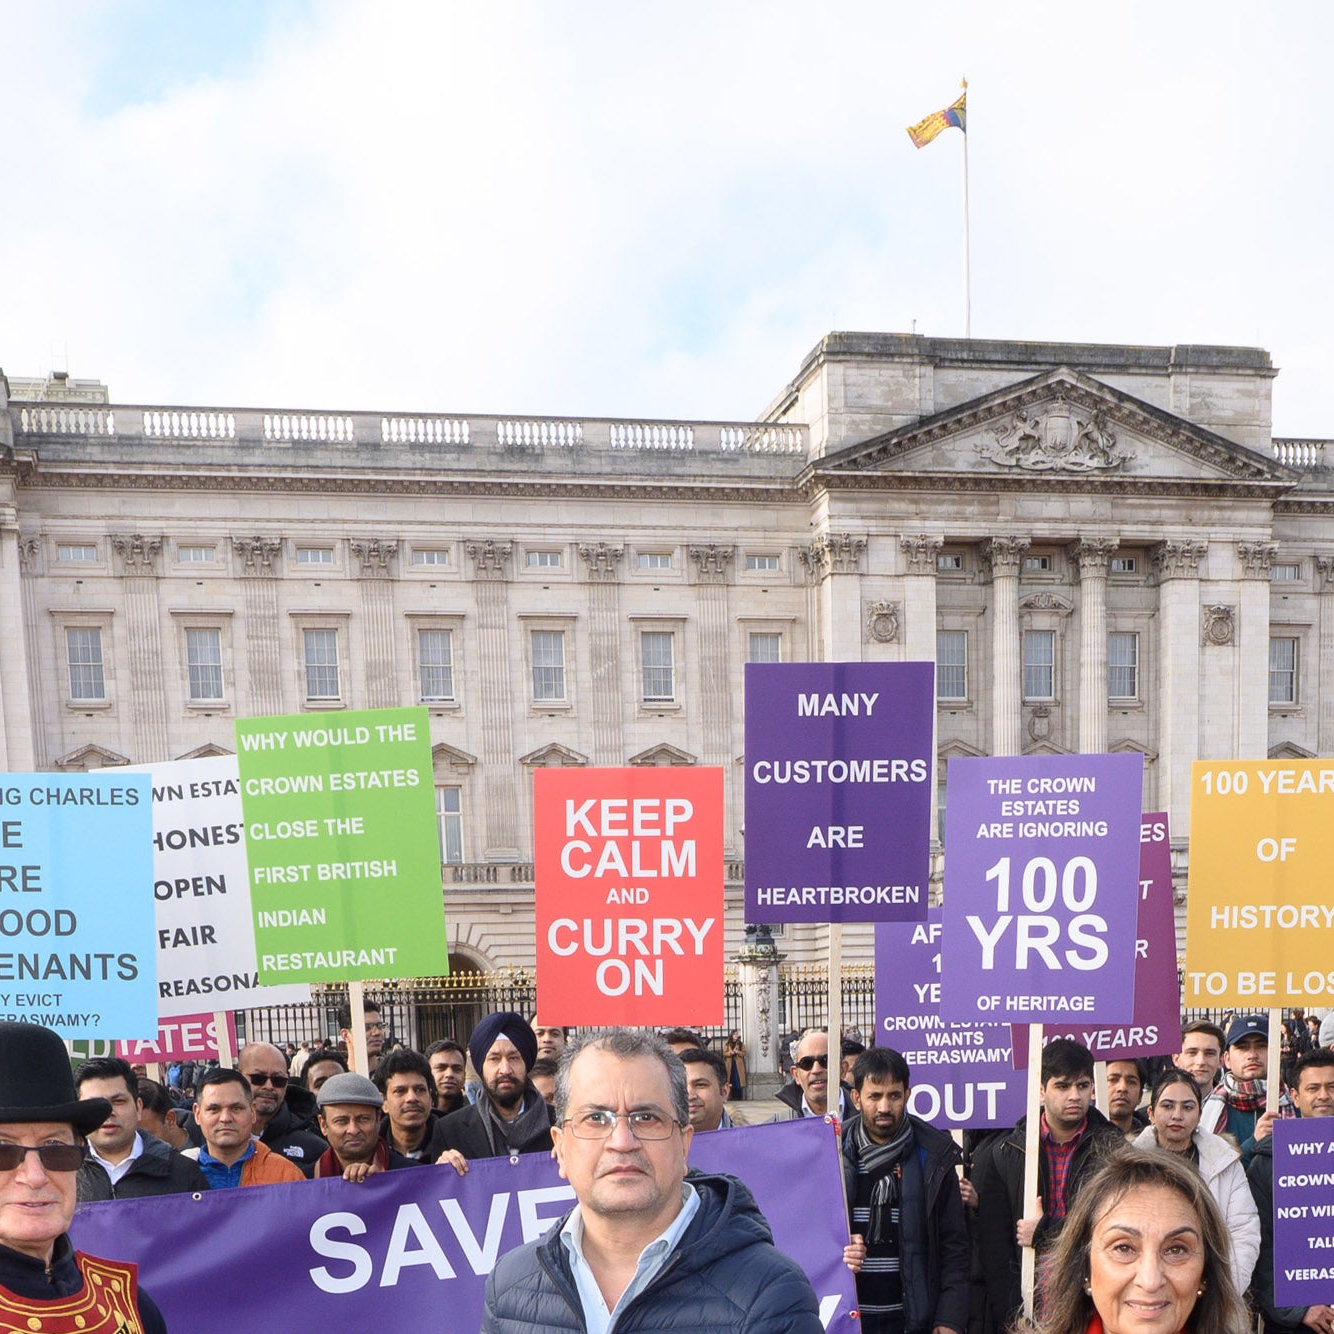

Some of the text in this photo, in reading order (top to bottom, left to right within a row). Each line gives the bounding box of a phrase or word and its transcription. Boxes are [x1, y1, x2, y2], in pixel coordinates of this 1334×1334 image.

[798, 693, 879, 716] MANY
[241, 724, 416, 751] WHY WOULD THE
[246, 769, 419, 796] CROWN ESTATES
[753, 759, 927, 783] CUSTOMERS
[1201, 771, 1248, 794] 100
[30, 788, 139, 805] CHARLES
[987, 777, 1095, 794] THE CROWN
[566, 799, 693, 836] KEEP
[1002, 800, 1079, 816] ESTATES
[250, 817, 364, 840] CLOSE THE
[807, 826, 863, 848] ARE
[977, 821, 1107, 838] ARE IGNORING
[561, 840, 696, 878] CALM
[1257, 838, 1296, 861] OF
[254, 860, 397, 884] FIRST BRITISH
[155, 875, 227, 900] OPEN
[758, 886, 919, 905] HEARTBROKEN
[986, 856, 1097, 912] 100
[606, 888, 649, 904] AND
[258, 908, 326, 928] INDIAN
[159, 925, 217, 949] FAIR
[548, 918, 715, 956] CURRY
[966, 914, 1108, 970] YRS
[262, 948, 397, 971] RESTAURANT
[596, 959, 663, 996] ON
[1189, 972, 1227, 995] TO
[1238, 972, 1276, 994] BE
[16, 994, 62, 1006] EVICT
[977, 996, 1094, 1011] OF HERITAGE
[926, 1031, 984, 1046] WANTS
[1083, 1026, 1158, 1050] YEARS
[907, 1082, 1006, 1122] OUT
[1288, 1143, 1324, 1155] WHY
[1279, 1174, 1334, 1187] CROWN
[1278, 1207, 1308, 1218] NOT
